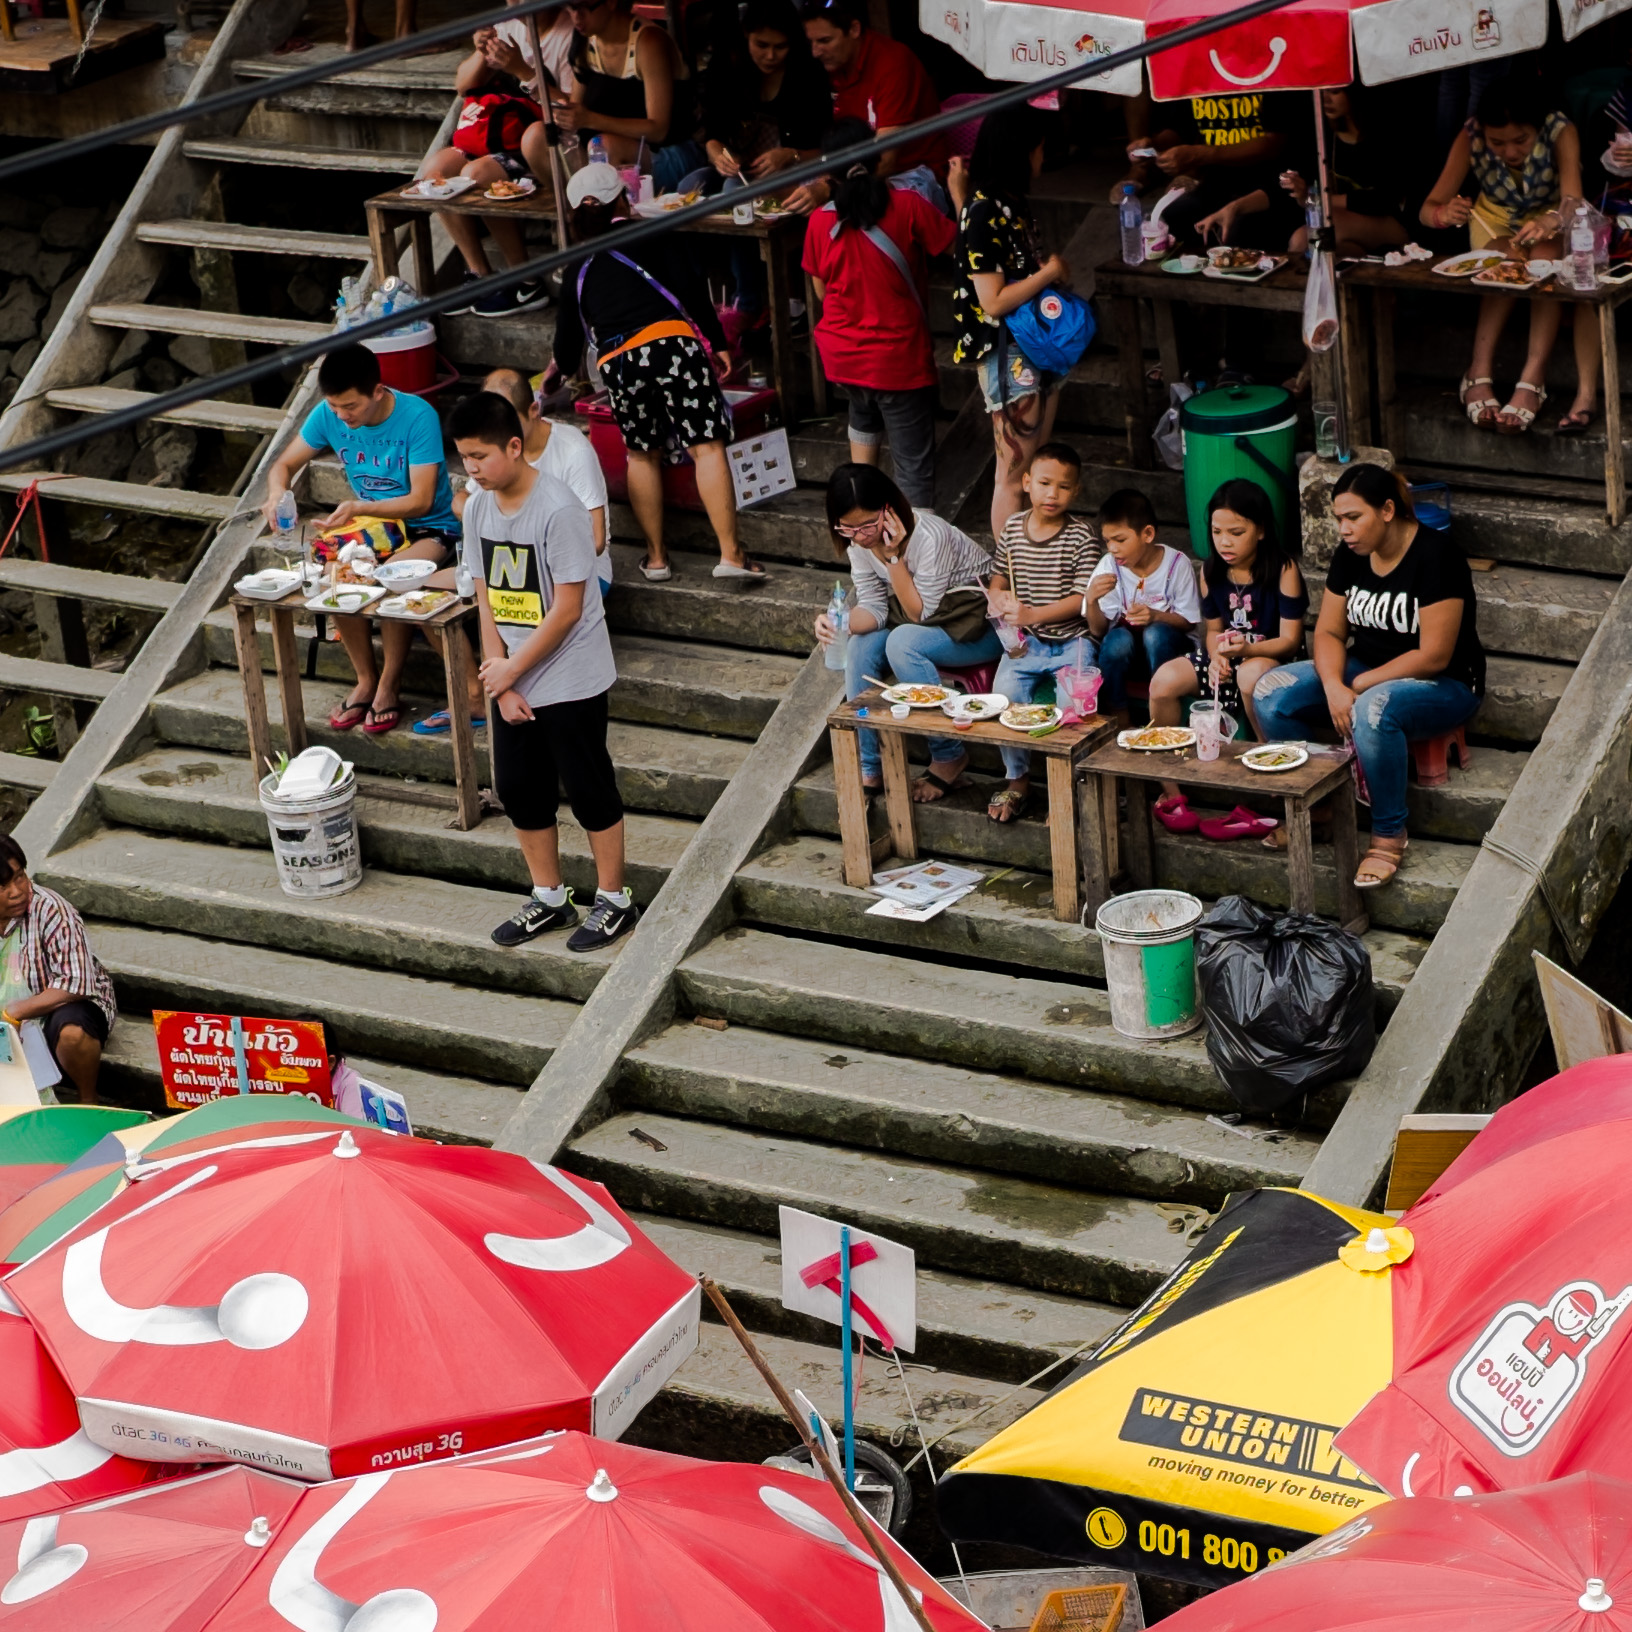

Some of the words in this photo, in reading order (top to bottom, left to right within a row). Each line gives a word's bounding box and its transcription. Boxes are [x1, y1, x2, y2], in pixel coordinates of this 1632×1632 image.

[1199, 125, 1265, 146] TRONG
[501, 595, 525, 606] new
[1505, 1352, 1546, 1388] แฮปปี้
[111, 1422, 148, 1441] dtac
[149, 1429, 168, 1443] 3G
[174, 1435, 192, 1449] 4G
[1141, 1394, 1300, 1445] WESTERN
[371, 1440, 434, 1467] ความสุข
[437, 1431, 464, 1452] 3G
[1180, 1425, 1292, 1466] UNION
[1148, 1456, 1214, 1482] moving
[1216, 1469, 1278, 1494] money
[1279, 1479, 1307, 1498] for
[1309, 1485, 1365, 1510] better
[1139, 1520, 1190, 1560] 001
[1202, 1534, 1258, 1573] 800
